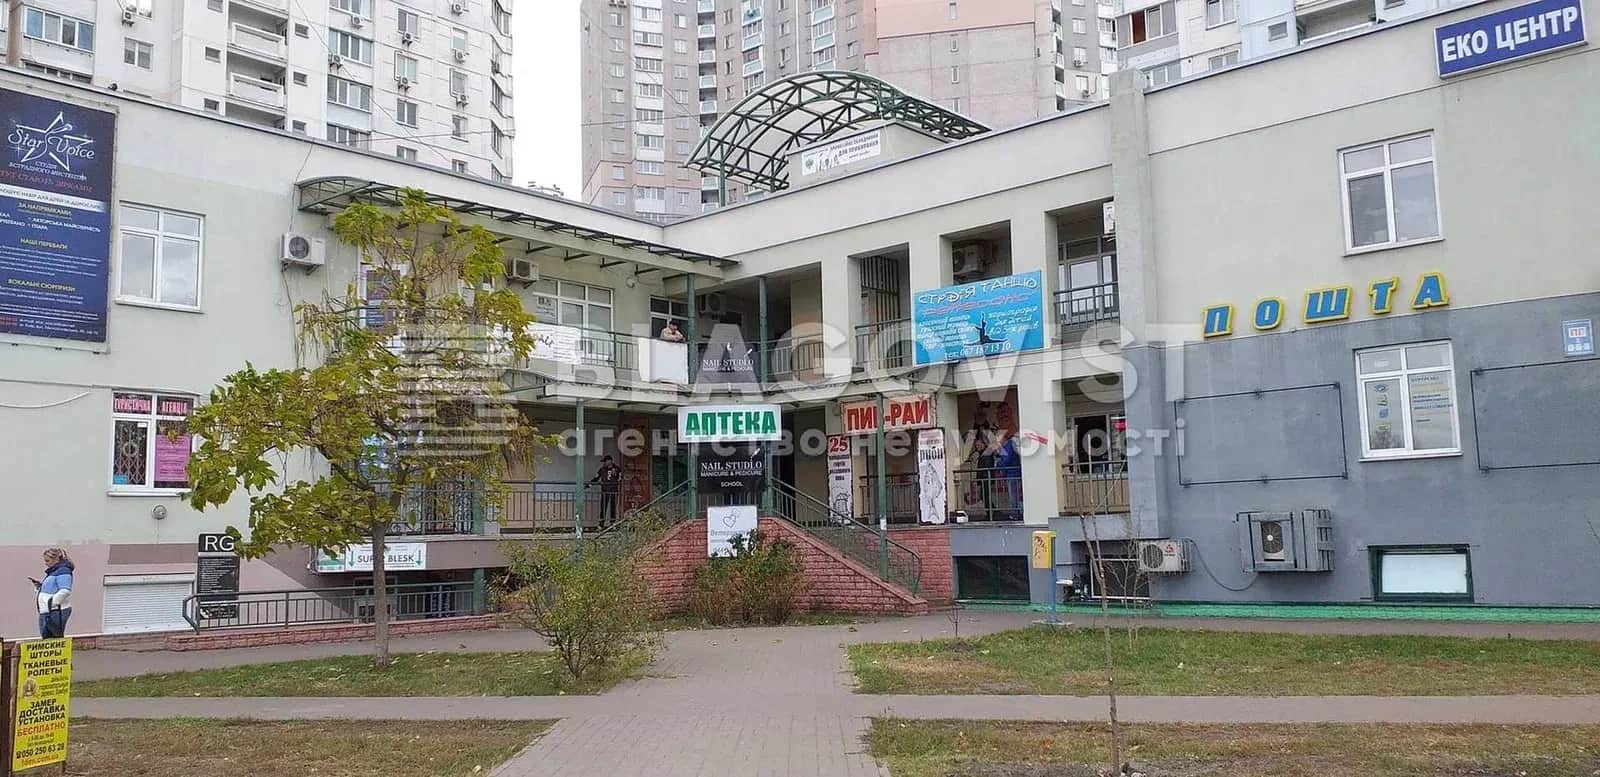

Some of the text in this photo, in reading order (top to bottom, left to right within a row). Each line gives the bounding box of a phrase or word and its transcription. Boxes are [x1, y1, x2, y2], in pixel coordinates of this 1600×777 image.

[1441, 6, 1578, 63] ЕКО ЦЕНТР
[8, 128, 95, 159] Star Voice
[1202, 271, 1451, 338] ПОШТА
[685, 410, 777, 435] АПТЕКА
[829, 435, 849, 452] 25
[700, 461, 763, 471] NAIL STUDIO
[204, 535, 235, 552] RG
[387, 554, 415, 563] BLESK
[26, 640, 67, 652] РИМСКИЕ
[30, 650, 62, 660] ШТОРЫ
[23, 658, 69, 670] ТКАНЕВЫЕ
[27, 667, 63, 678] РОЛЕТЫ
[30, 698, 57, 709] ЗАМЕР
[19, 704, 66, 719] ДОСТАВКА
[18, 712, 66, 726] УСТАНОВКА
[17, 721, 66, 737] БЕСПЛАТНО
